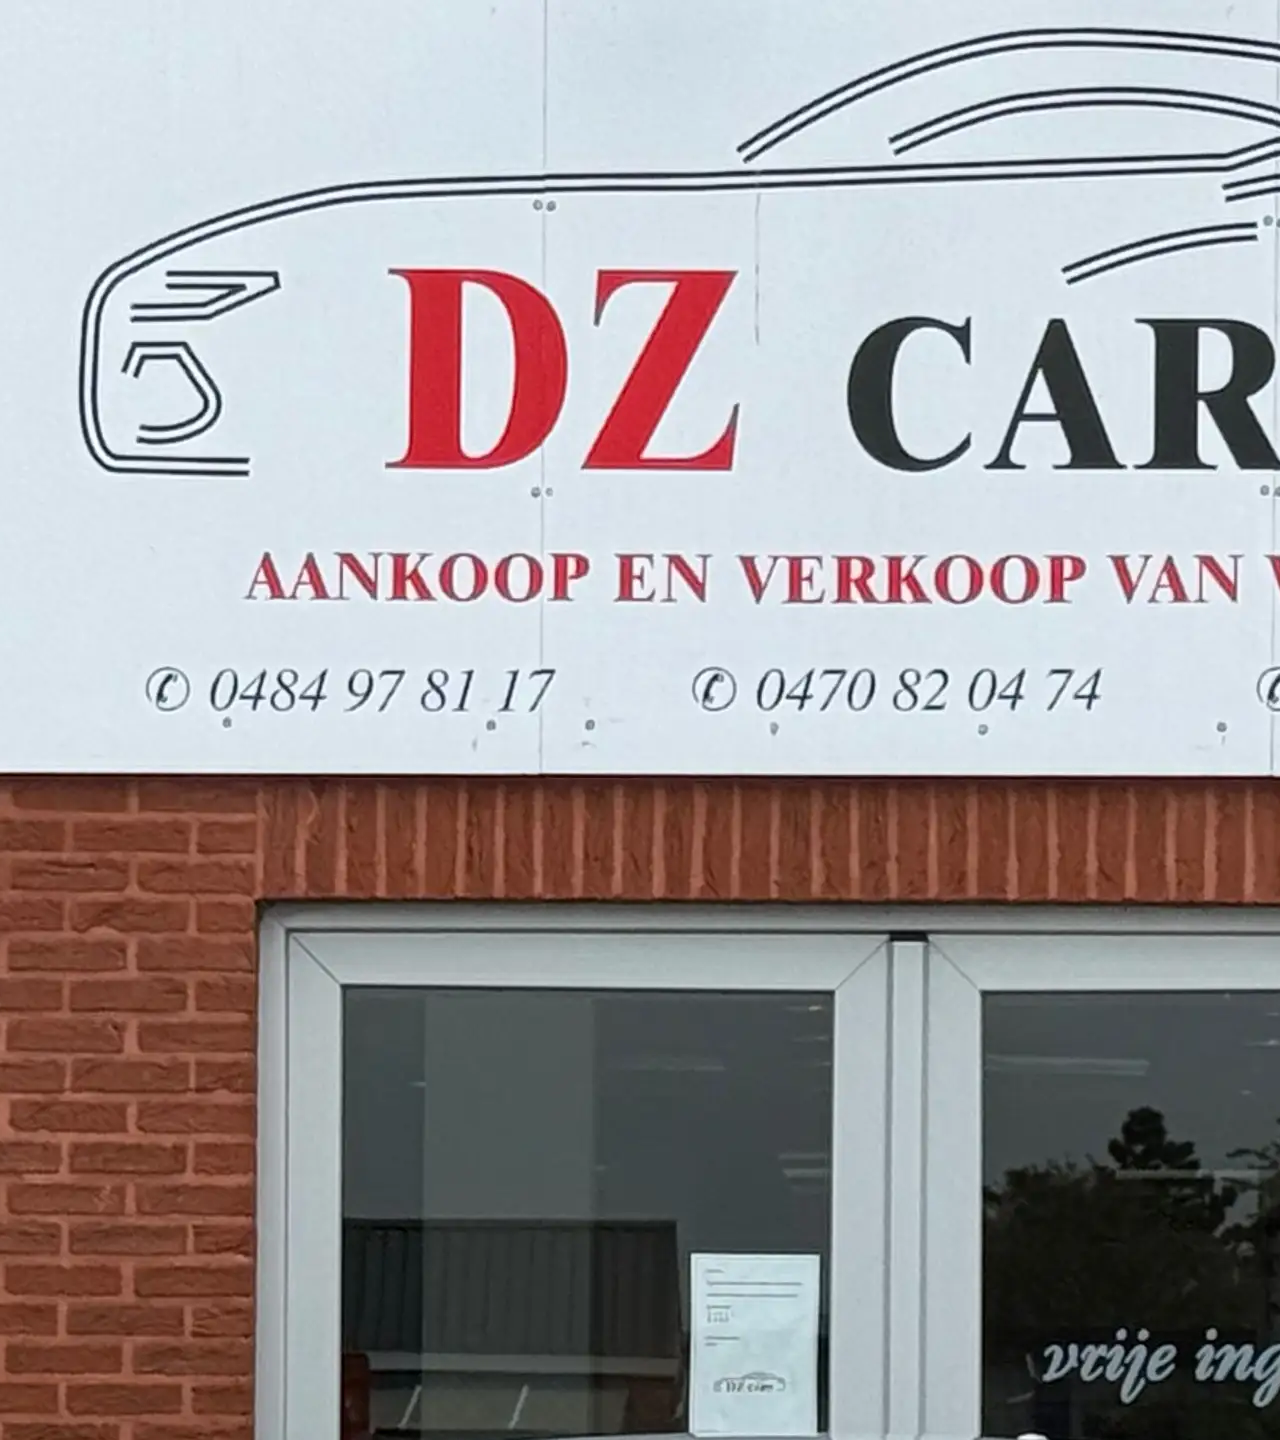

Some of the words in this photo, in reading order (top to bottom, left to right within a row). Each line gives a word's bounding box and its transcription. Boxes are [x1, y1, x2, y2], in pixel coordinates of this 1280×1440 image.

[385, 268, 740, 471] DZ
[245, 551, 590, 603] AANKOOP
[614, 553, 712, 603] EN
[738, 554, 1088, 605] VERKOOP
[1107, 554, 1243, 604] VAN
[210, 668, 329, 712] 0484
[348, 669, 406, 712] 97
[420, 668, 475, 712] 81
[498, 668, 556, 712] 17
[756, 668, 877, 712] 0470
[892, 668, 949, 712] 82
[968, 668, 1027, 712] 04
[1046, 668, 1101, 712] 74
[1042, 1328, 1177, 1404] vrije
